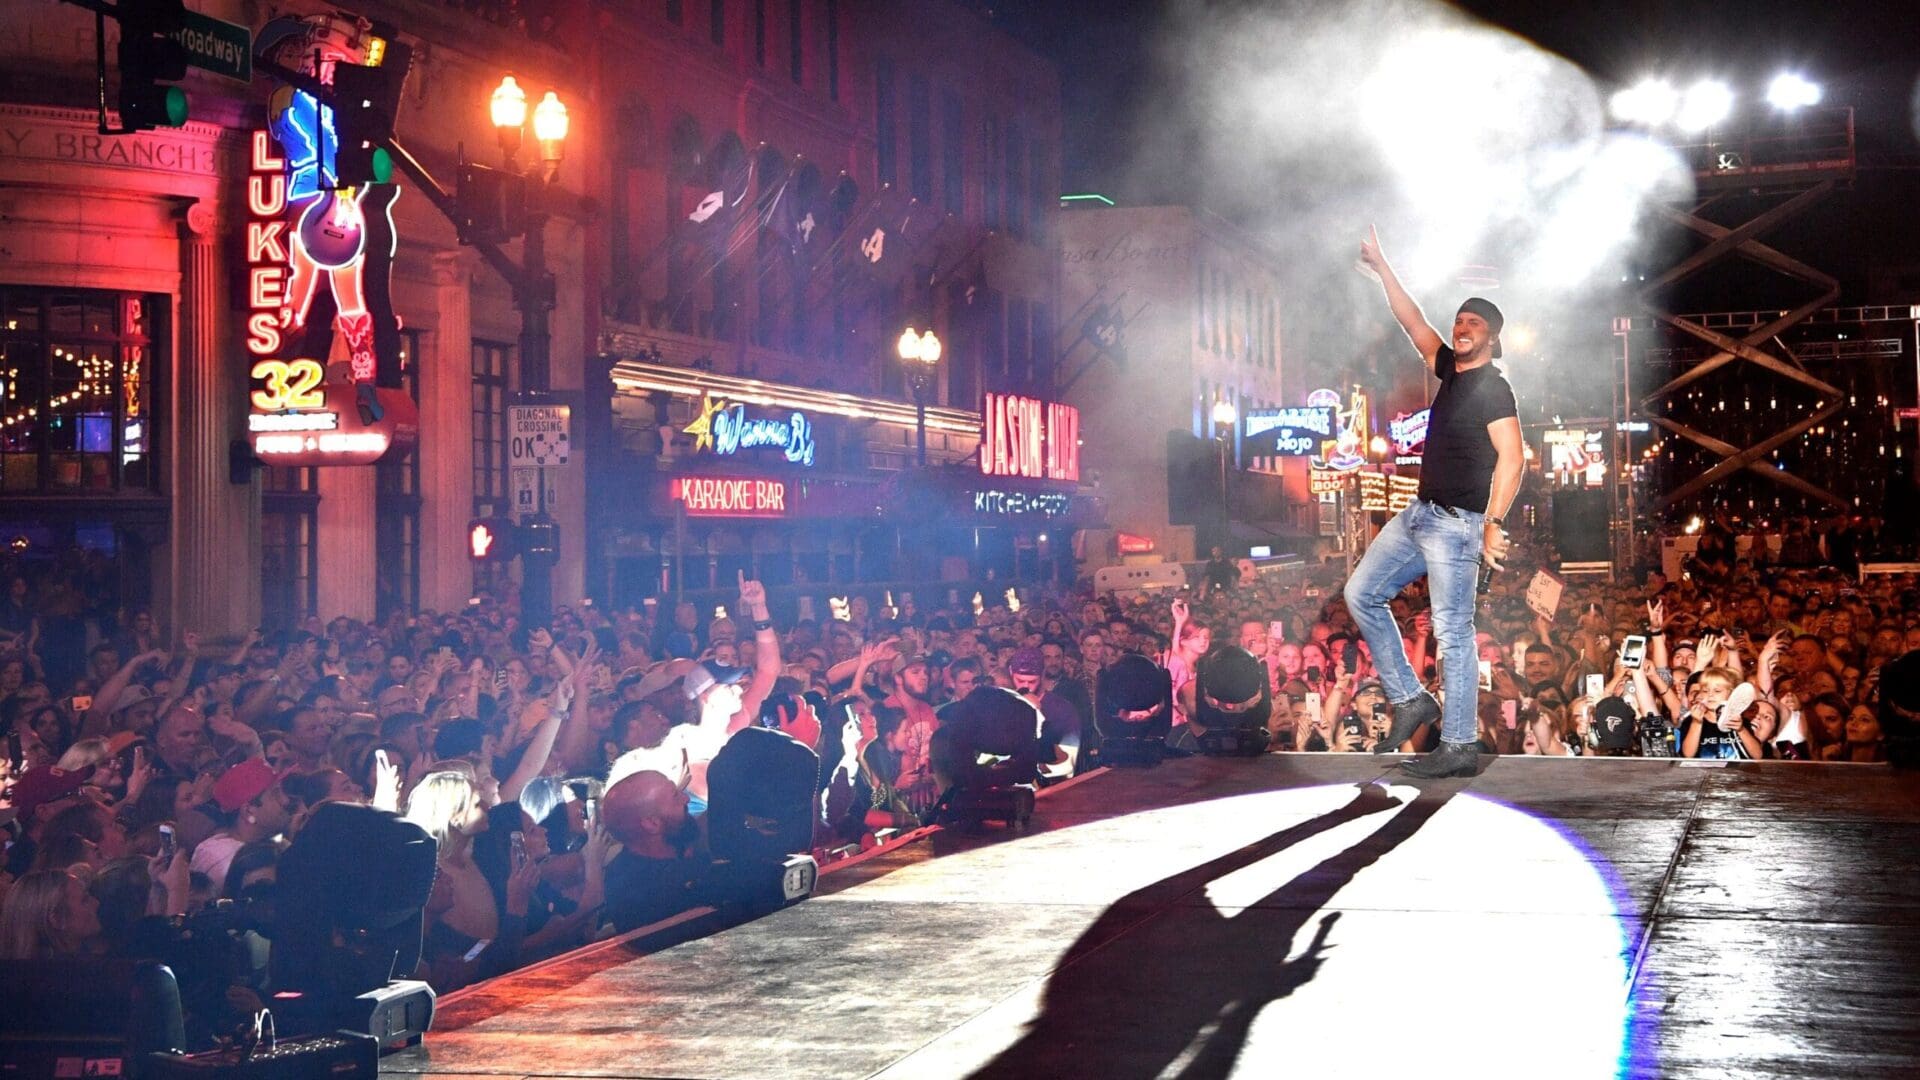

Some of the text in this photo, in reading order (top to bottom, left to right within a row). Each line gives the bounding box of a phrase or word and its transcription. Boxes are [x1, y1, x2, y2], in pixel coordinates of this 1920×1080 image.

[171, 30, 243, 72] roadway
[2, 129, 32, 149] Y
[54, 133, 196, 171] BRANCH
[251, 358, 325, 411] 32
[516, 408, 563, 420] DIAGONAL
[517, 421, 562, 432] CROSSING
[714, 403, 790, 455] Wanna
[512, 437, 535, 458] OK
[981, 392, 1042, 477] JASON
[682, 478, 784, 510] KARAOKE BAR
[975, 491, 1030, 513] KITCHEN
